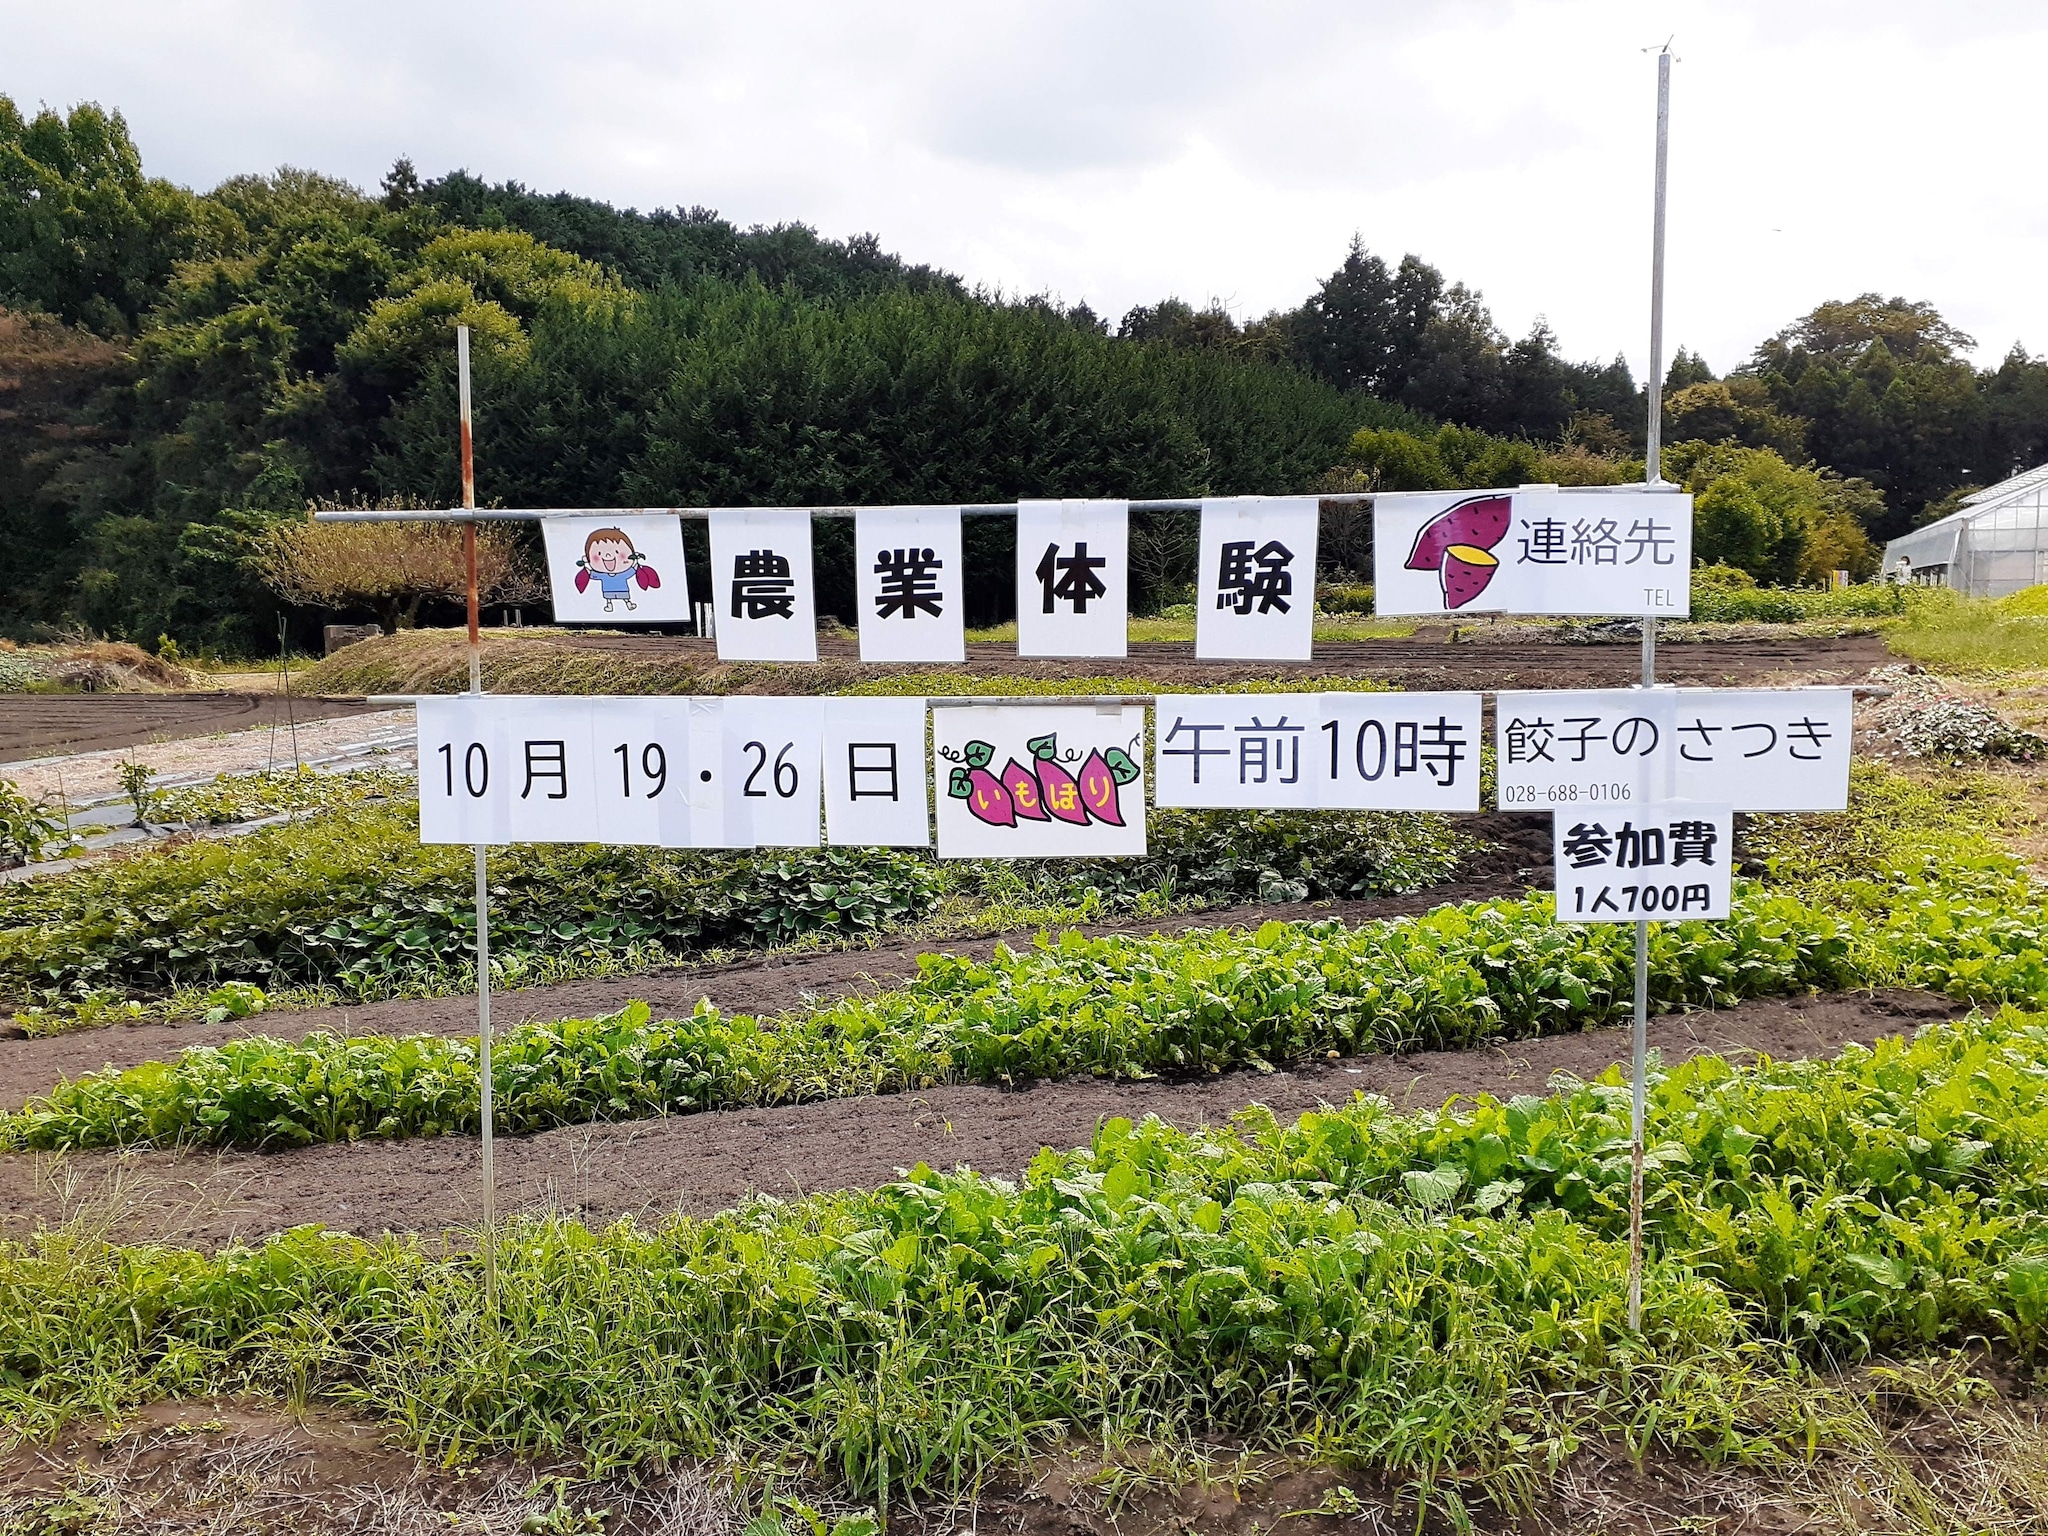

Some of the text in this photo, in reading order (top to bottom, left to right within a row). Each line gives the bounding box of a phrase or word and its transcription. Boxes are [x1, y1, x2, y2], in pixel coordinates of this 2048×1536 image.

[1516, 516, 1676, 566] 連絡先
[1643, 588, 1676, 607] TEL
[1161, 715, 1468, 788] 午前10時
[1504, 715, 1833, 765] 餃子のさつき
[976, 775, 1111, 811] いもほり
[1505, 782, 1632, 804] 028-688-0106
[1562, 820, 1718, 870] 参加費
[1573, 882, 1711, 914] 1人700円
